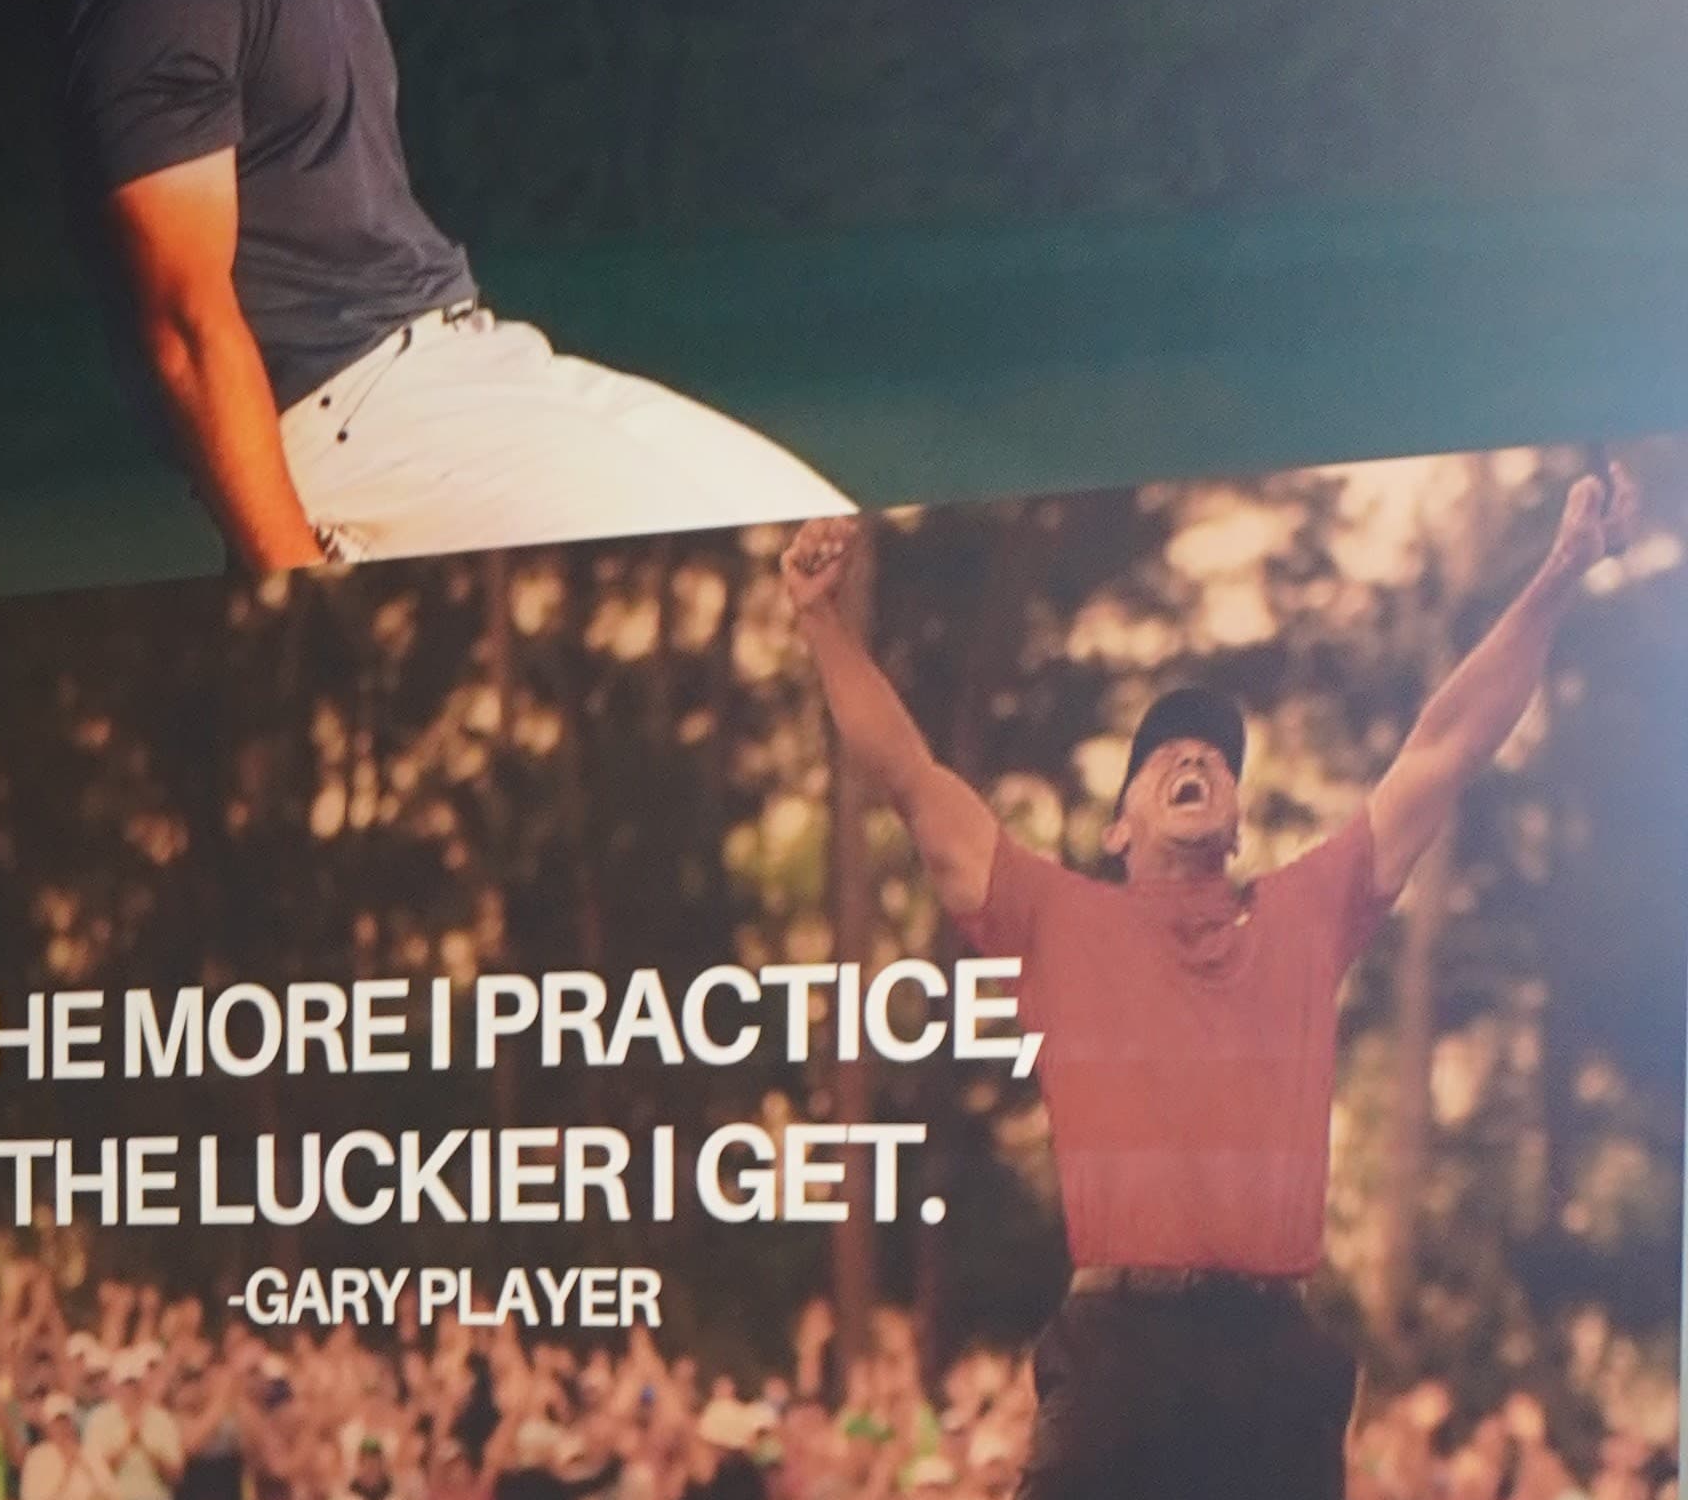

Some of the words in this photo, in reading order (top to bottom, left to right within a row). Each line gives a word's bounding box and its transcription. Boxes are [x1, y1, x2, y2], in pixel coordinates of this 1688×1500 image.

[124, 979, 411, 1078] MORE
[430, 977, 451, 1071] I
[475, 956, 1046, 1079] PRACTICE,
[199, 1126, 631, 1226] LUCKIER
[652, 1125, 674, 1222] I
[696, 1122, 947, 1226] GET.
[227, 1267, 411, 1326] -GARY
[419, 1267, 663, 1328] PLAYER
